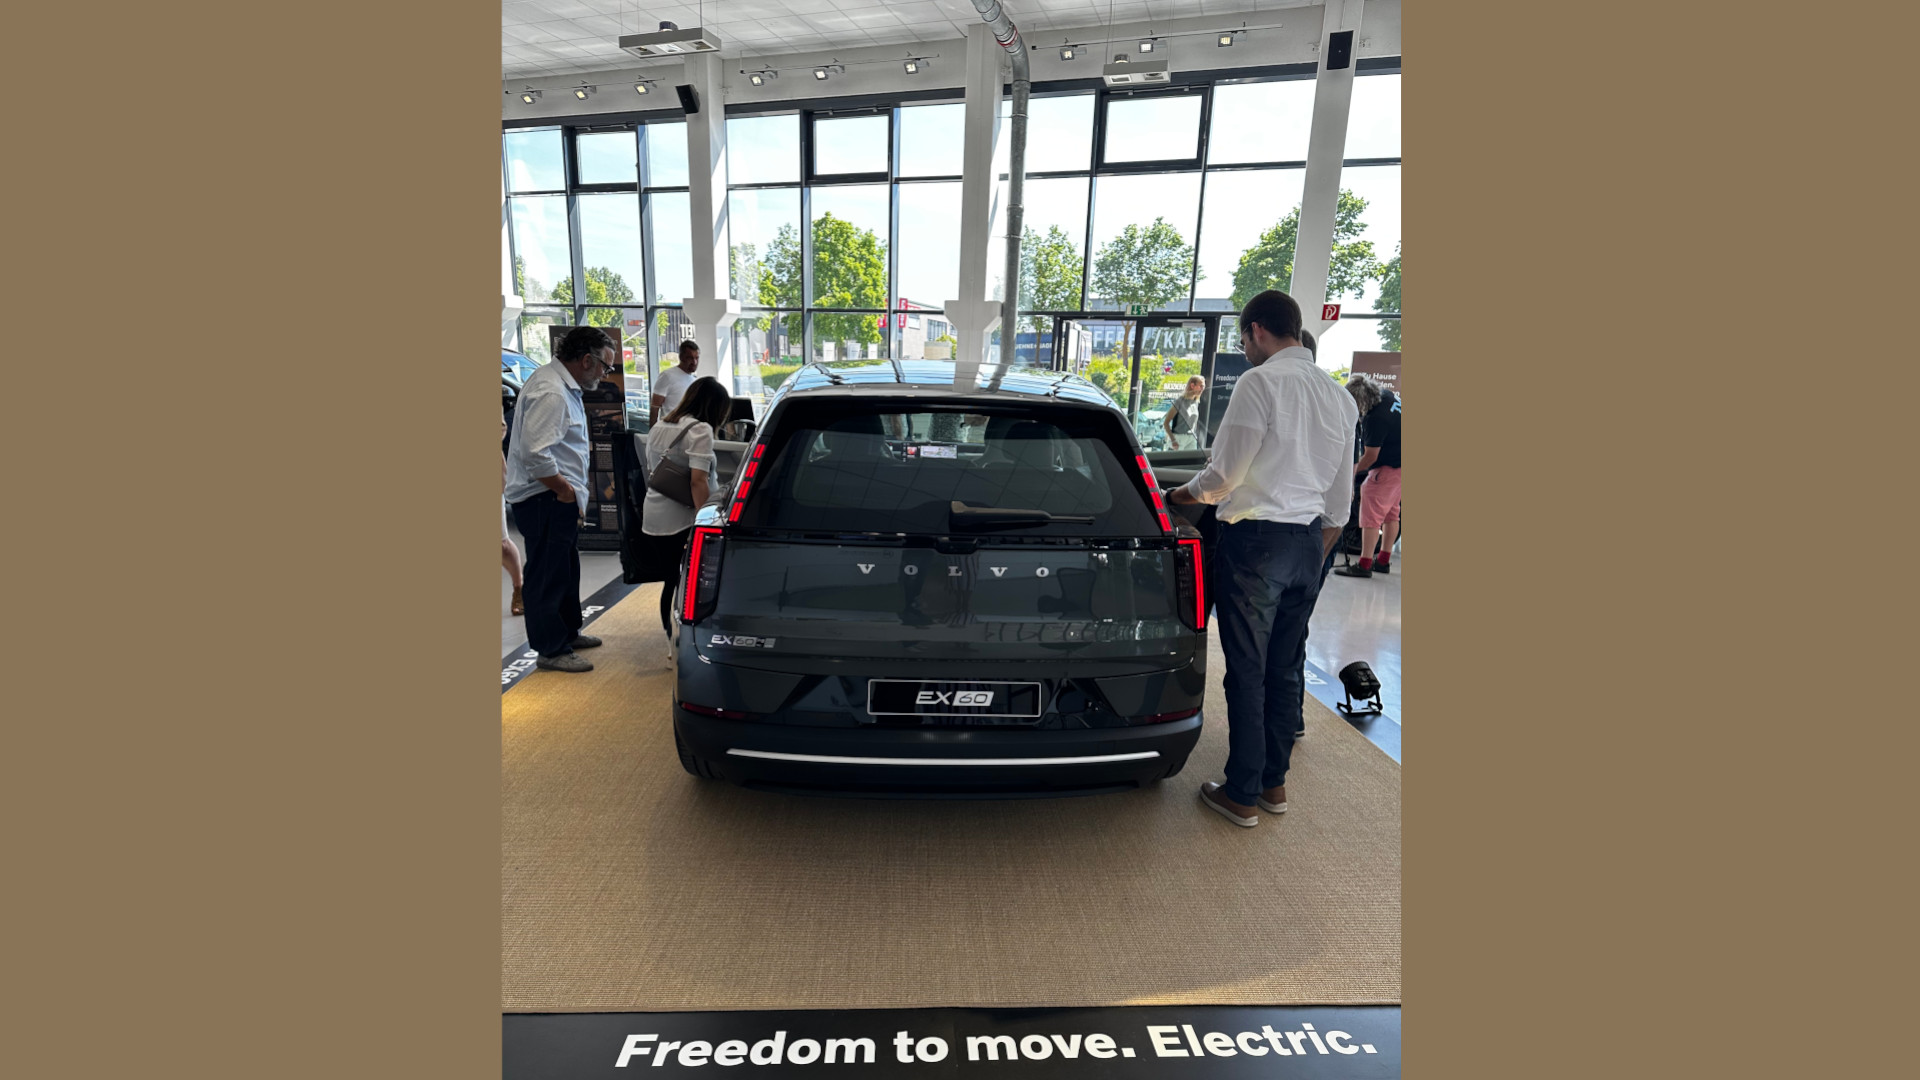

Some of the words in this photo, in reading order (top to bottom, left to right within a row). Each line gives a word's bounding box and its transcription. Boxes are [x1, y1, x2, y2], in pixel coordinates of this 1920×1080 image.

[1215, 373, 1236, 382] Freedom
[1372, 372, 1397, 381] Hause
[857, 563, 1050, 578] VOLVO
[915, 690, 995, 707] EX60
[614, 1030, 876, 1068] Freedom
[893, 1030, 949, 1064] to
[966, 1033, 1137, 1061] move.
[1146, 1022, 1378, 1059] Electric.
